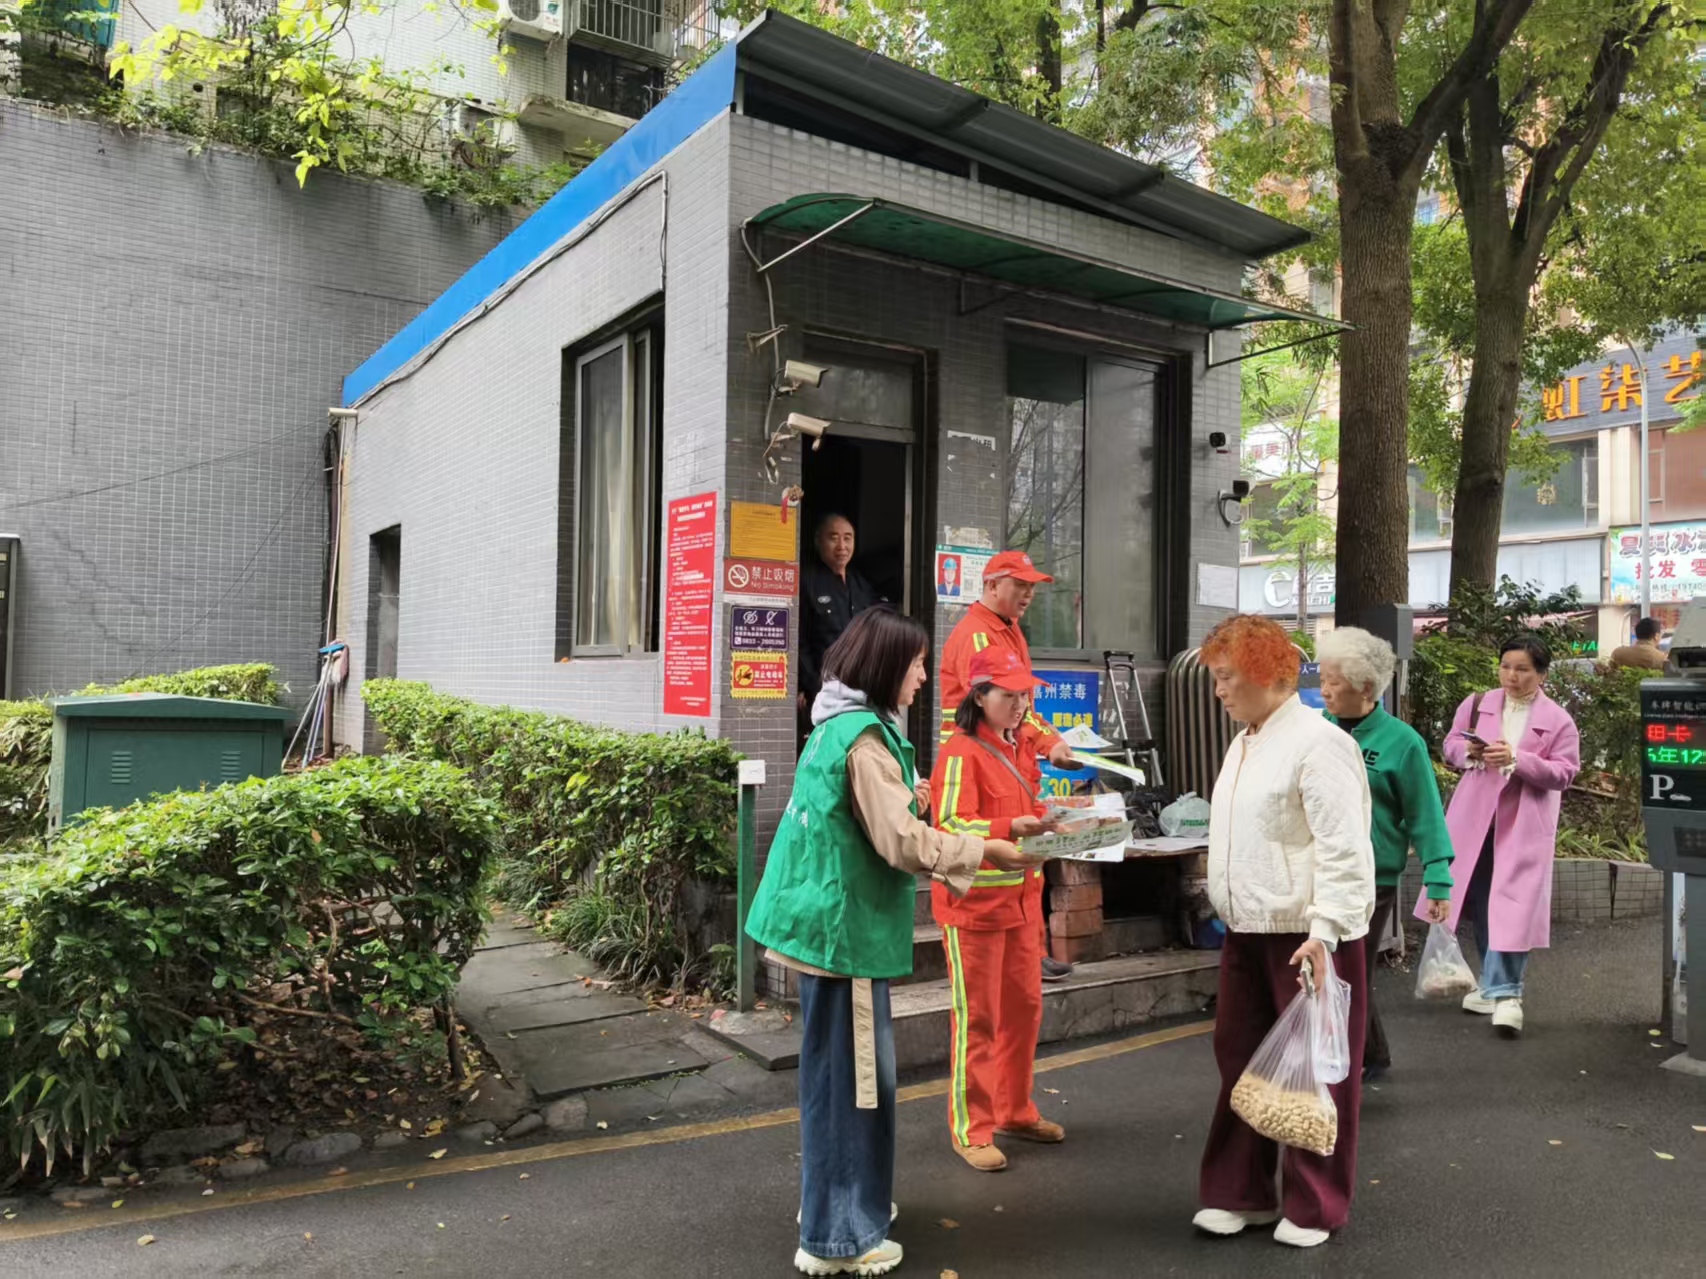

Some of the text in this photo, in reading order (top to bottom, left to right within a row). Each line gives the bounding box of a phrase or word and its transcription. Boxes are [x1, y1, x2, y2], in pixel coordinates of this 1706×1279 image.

[751, 566, 794, 582] 禁止吸烟
[751, 581, 762, 589] No
[1649, 774, 1675, 800] P
